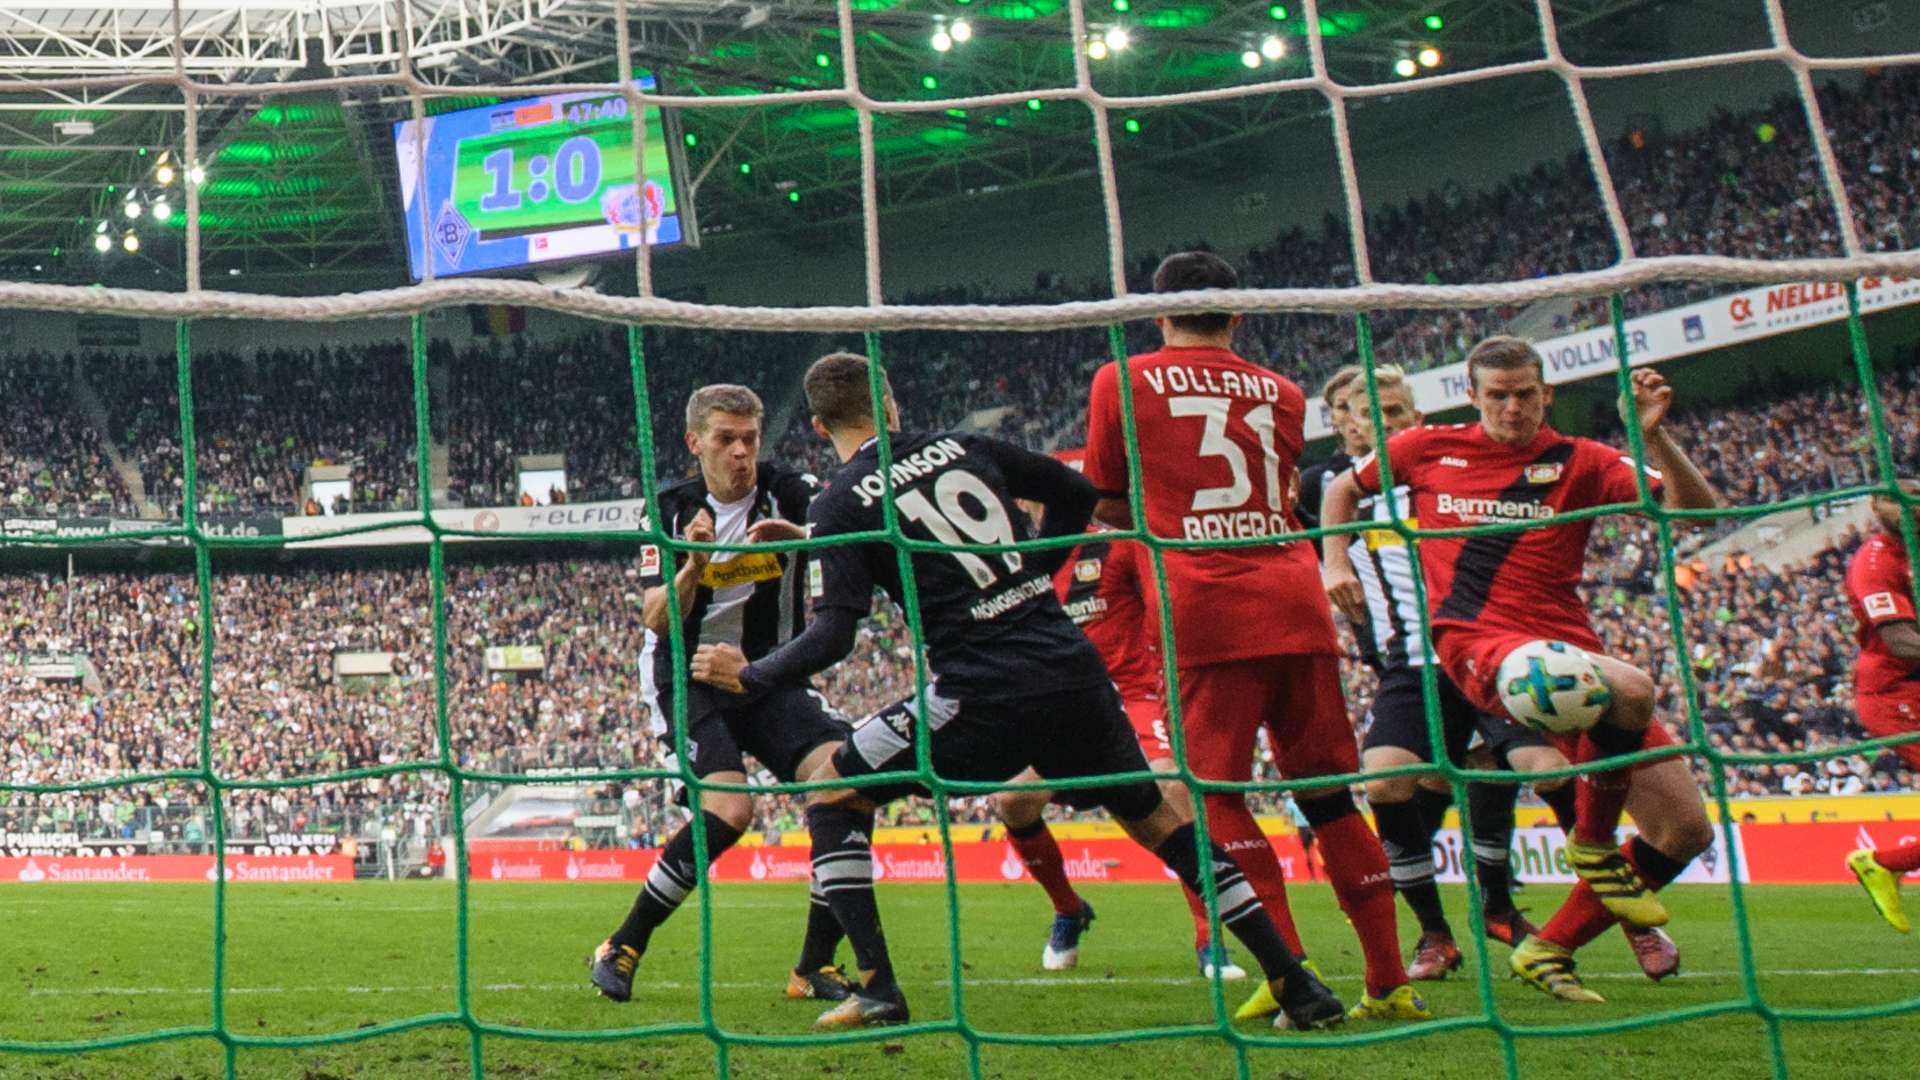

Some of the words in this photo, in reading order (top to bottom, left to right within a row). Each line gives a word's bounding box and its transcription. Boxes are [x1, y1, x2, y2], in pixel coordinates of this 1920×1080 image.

[566, 98, 628, 124] 47:40
[480, 136, 602, 212] 1:0
[1143, 365, 1278, 403] VOLLAND
[1168, 396, 1283, 512] 31
[1437, 493, 1554, 519] Barmenia
[894, 468, 1023, 590] 19
[1182, 511, 1266, 549] BAYER
[235, 859, 335, 881] Santander
[1360, 871, 1391, 886] JAK
